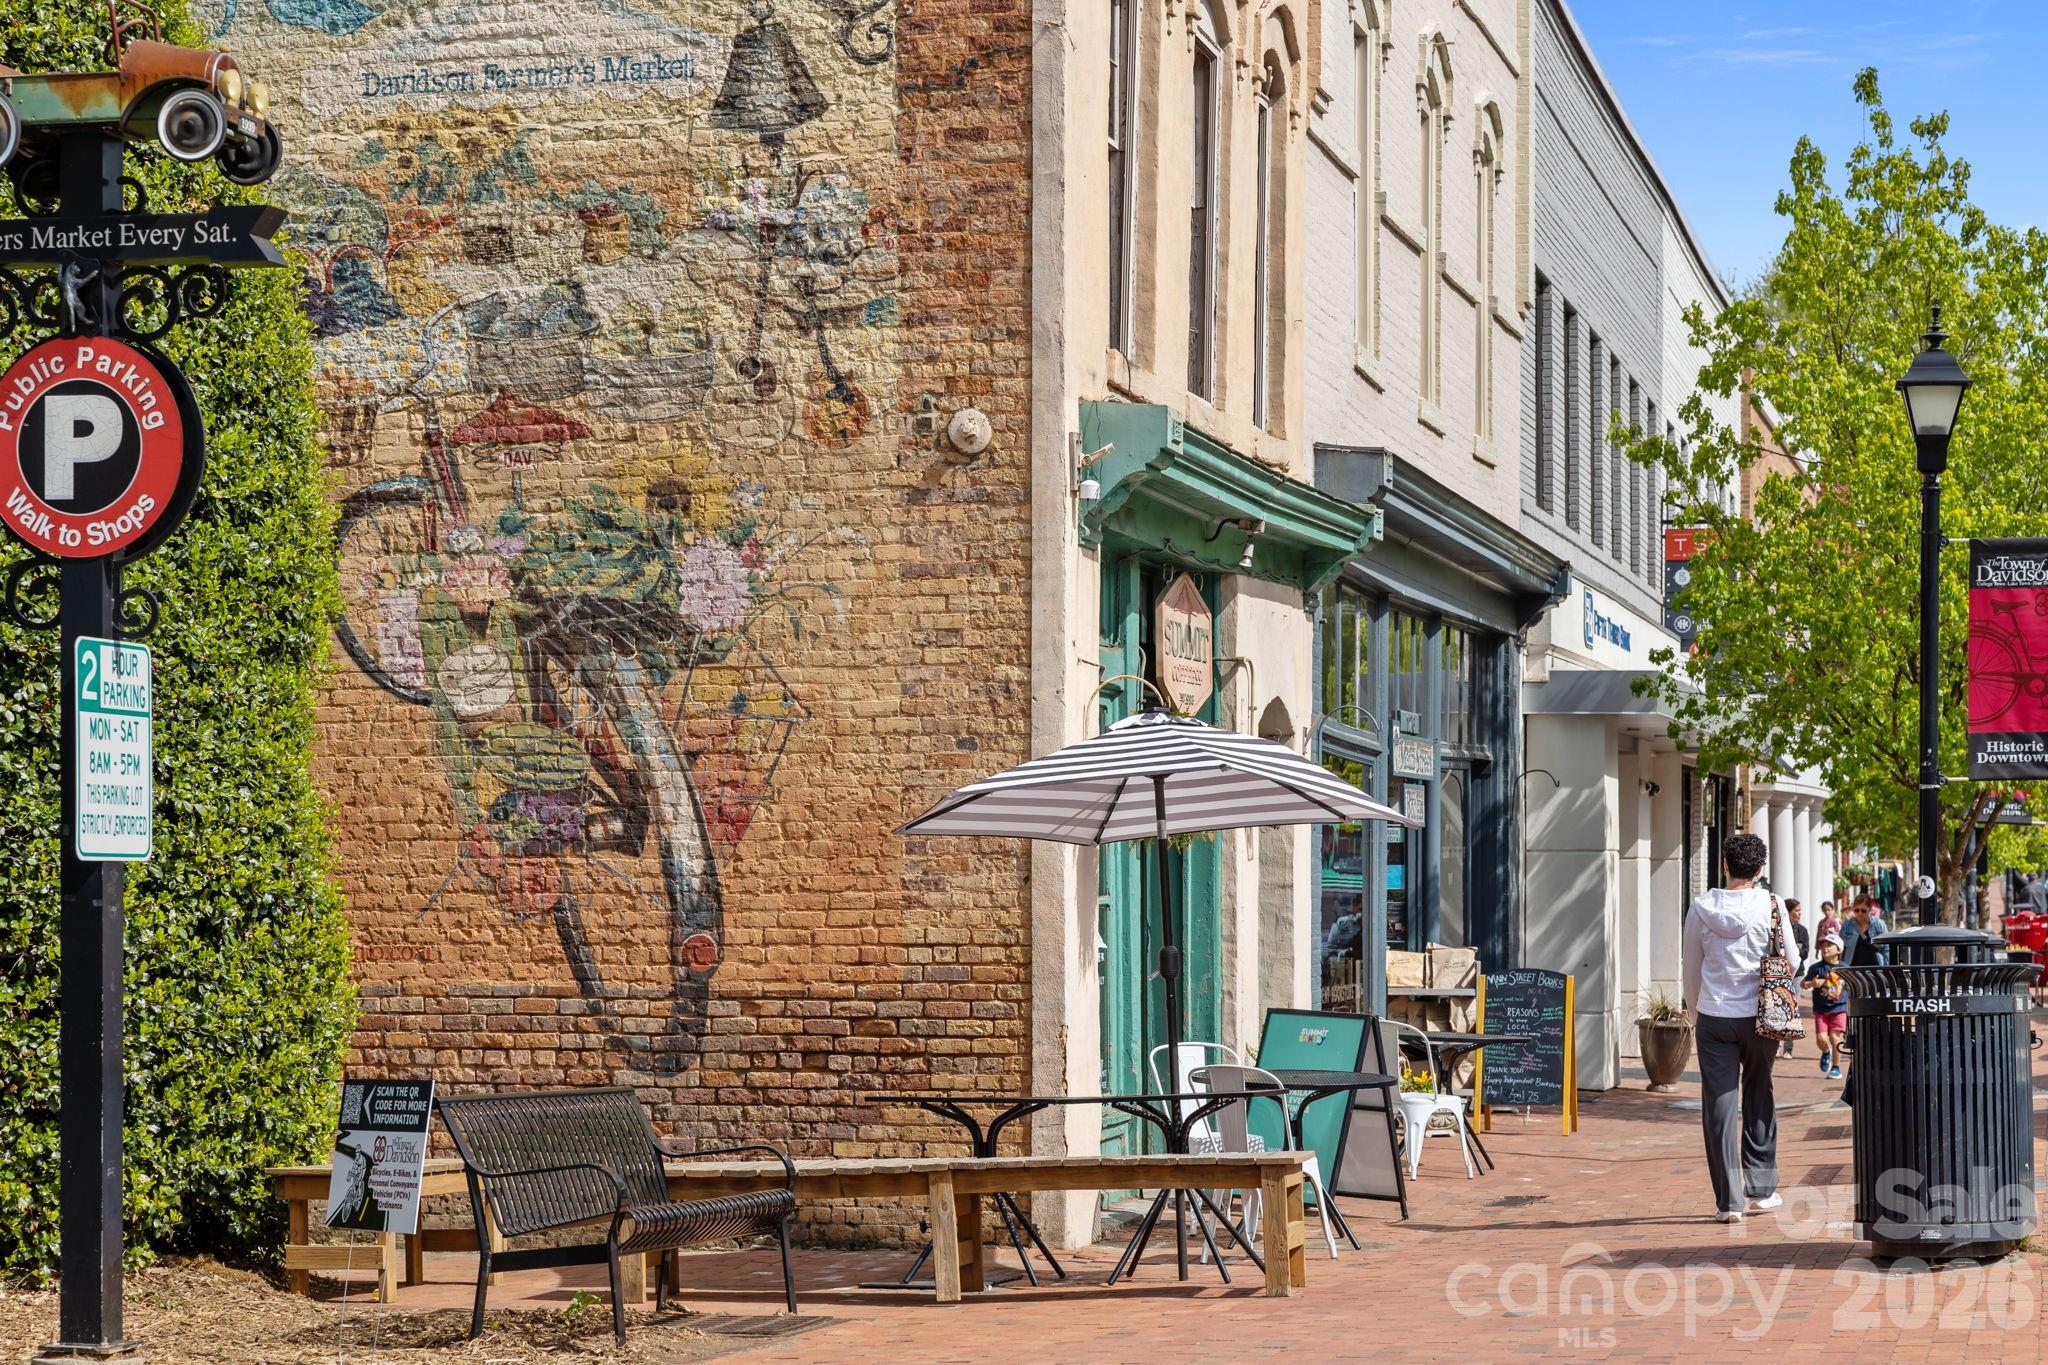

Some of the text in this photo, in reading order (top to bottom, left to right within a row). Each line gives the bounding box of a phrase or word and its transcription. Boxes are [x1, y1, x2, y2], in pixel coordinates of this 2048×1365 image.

[362, 52, 695, 97] Davidson Farmer's Market
[30, 224, 112, 250] Market
[119, 222, 186, 251] Every
[194, 219, 237, 245] Sat.
[0, 346, 165, 431] Public Parking
[44, 394, 123, 500] P
[6, 486, 156, 547] Walk to Shops
[1986, 556, 2048, 571] The Town of
[111, 650, 139, 679] HOUR
[81, 649, 98, 700] 2
[103, 681, 146, 709] PARKING
[89, 717, 112, 741] MON
[120, 721, 139, 743] SAT
[1986, 740, 2044, 752] Historic
[89, 750, 111, 775] 8AM
[120, 753, 141, 776] 5PM
[87, 783, 143, 806] THIS PARKING LOT
[81, 814, 147, 836] STRICTLY ENFORCED
[1486, 971, 1564, 989] MAIN STREET BOOKS
[1507, 1008, 1539, 1018] REASONS
[1893, 998, 1950, 1013] TRASH
[1486, 1066, 1508, 1074] THANK
[1484, 1075, 1502, 1085] Happy
[377, 1086, 420, 1100] SCAN THE QR
[1528, 1090, 1539, 1101] 25
[375, 1100, 428, 1111] CODE FOR MORE
[373, 1113, 420, 1125] INFORMATION
[385, 1145, 420, 1164] Davidson
[379, 1200, 403, 1210] Ordinance
